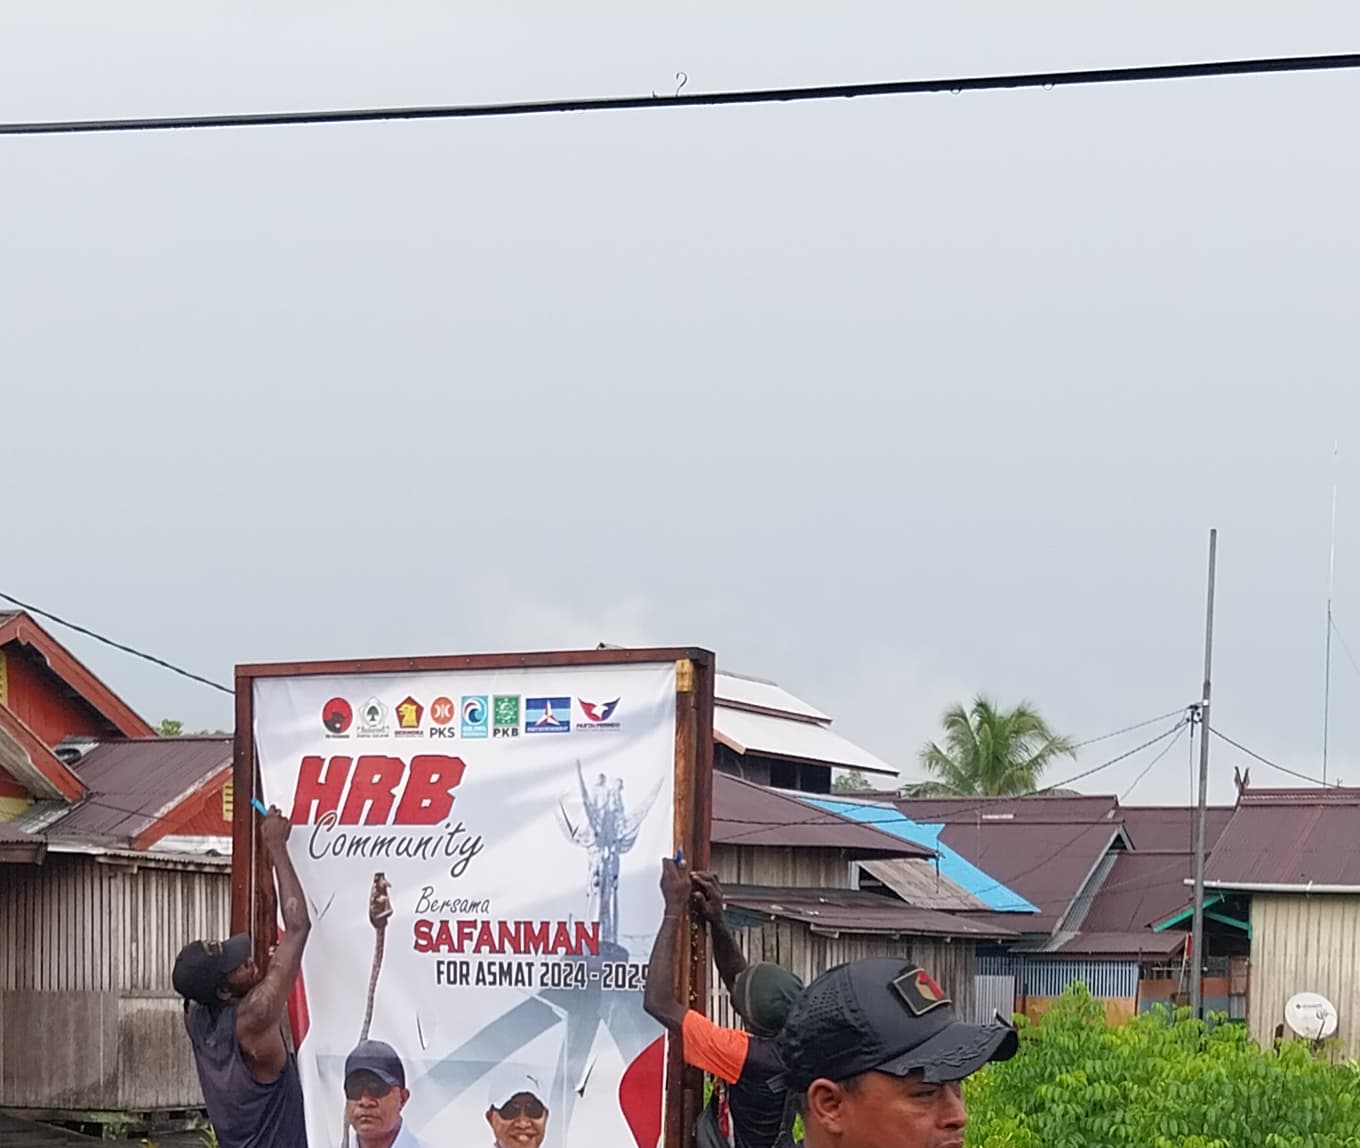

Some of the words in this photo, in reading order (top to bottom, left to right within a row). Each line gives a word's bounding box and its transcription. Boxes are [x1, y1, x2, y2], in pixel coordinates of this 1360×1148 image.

[429, 727, 456, 739] PKS
[492, 727, 520, 738] PKB
[291, 754, 466, 826] HRB
[309, 812, 485, 878] Community
[415, 886, 490, 915] Bersama
[413, 919, 600, 956] SAFANMAN
[436, 960, 470, 986] FOR
[475, 961, 535, 988] ASMAT
[540, 962, 587, 989] 2024
